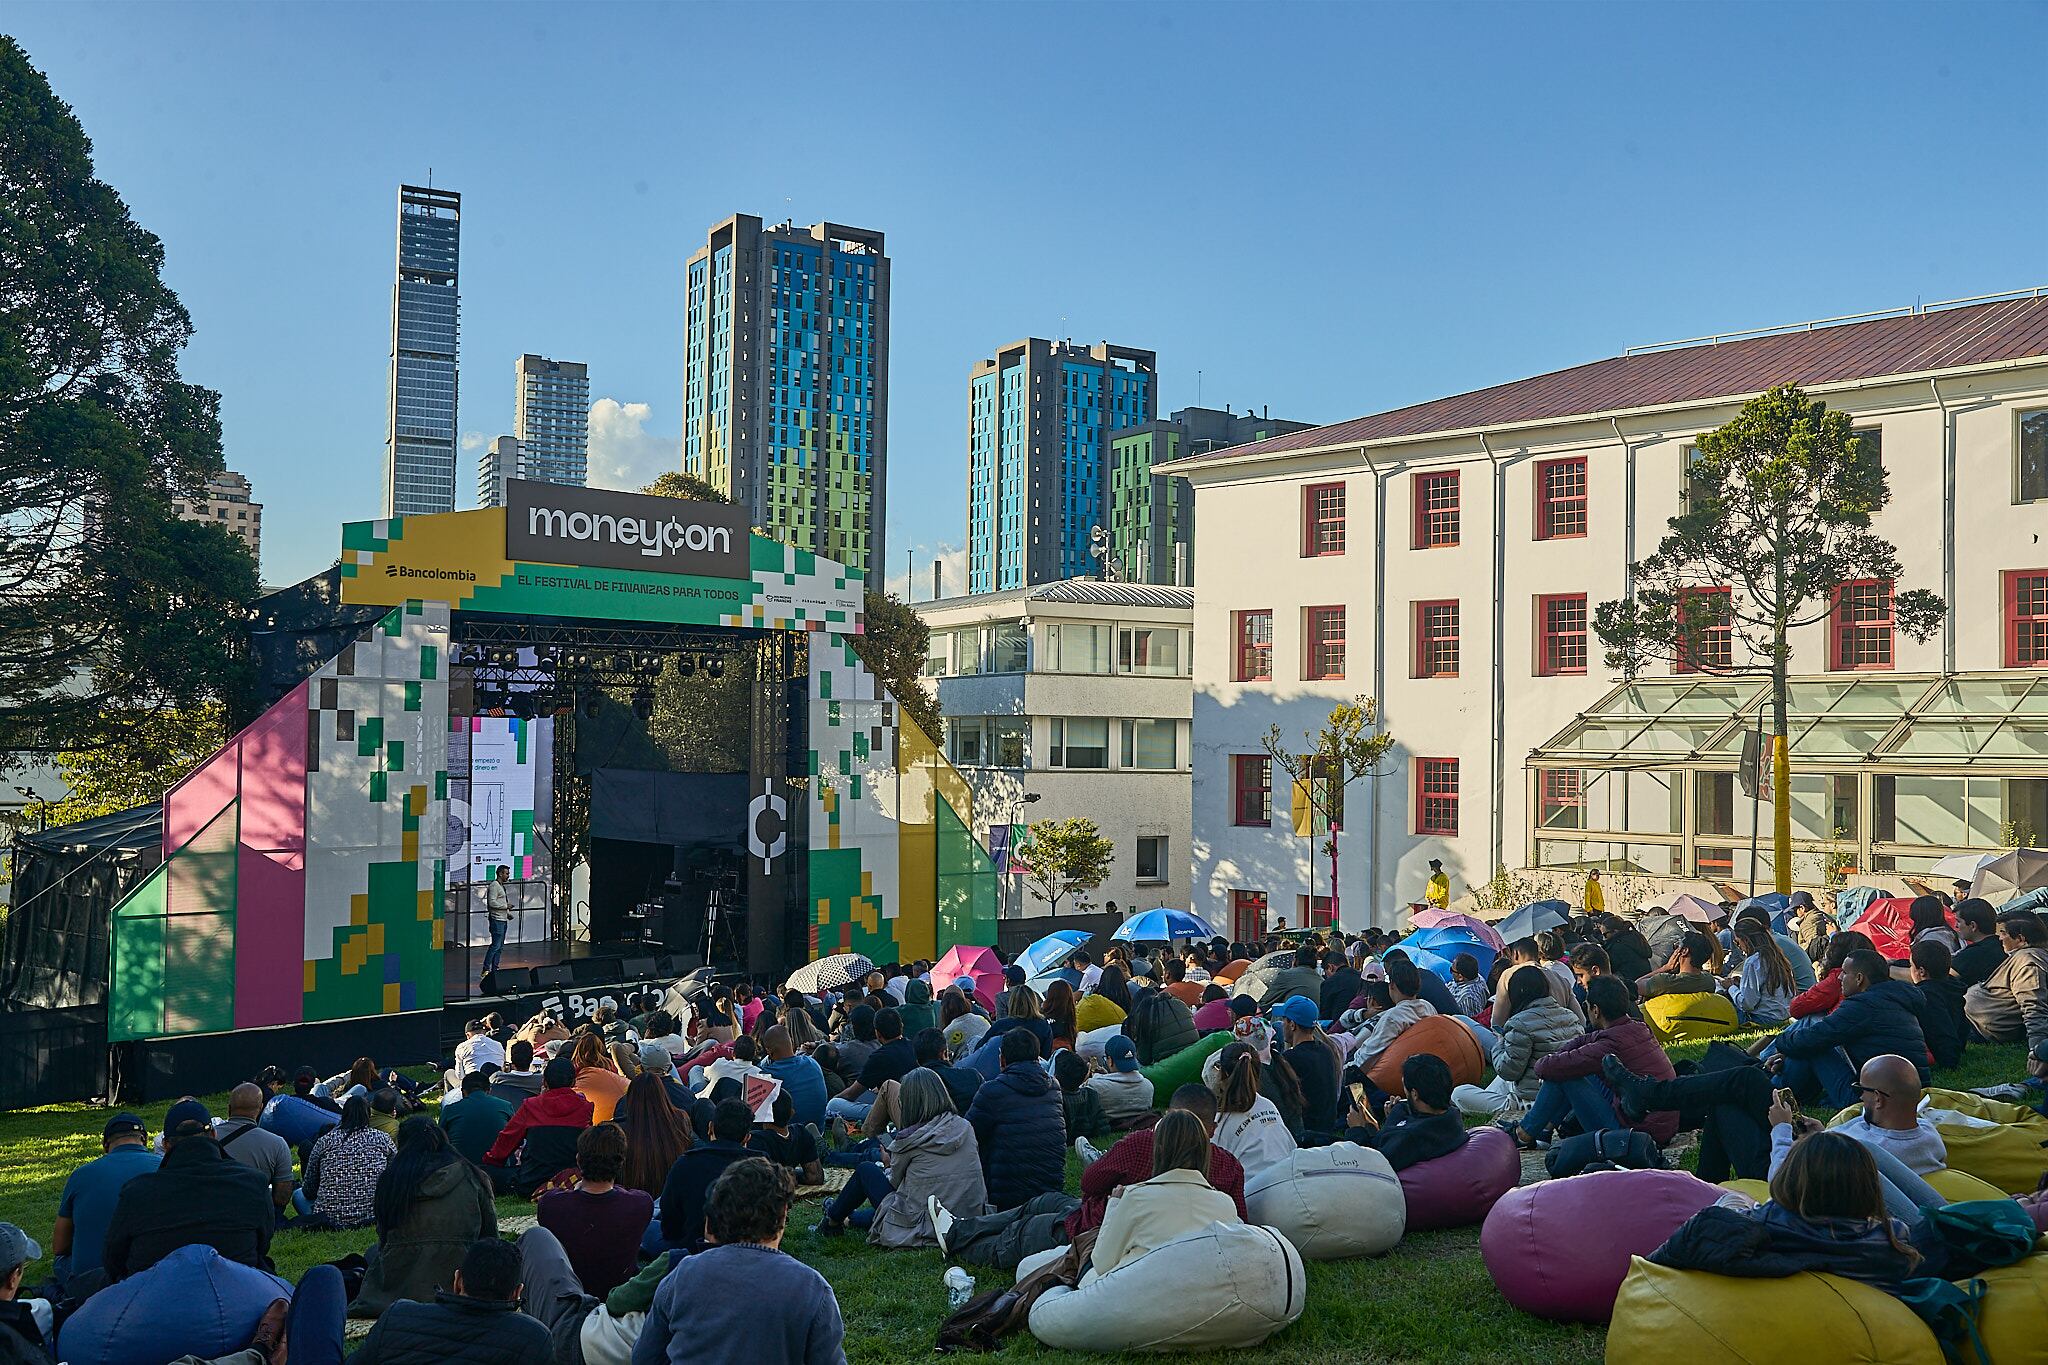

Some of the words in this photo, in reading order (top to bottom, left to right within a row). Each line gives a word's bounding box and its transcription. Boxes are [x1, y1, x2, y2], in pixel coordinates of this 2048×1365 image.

[399, 566, 476, 581] Bancolombia
[518, 575, 532, 586] EL
[535, 576, 591, 590] FESTIVAL
[594, 580, 609, 591] DE
[611, 581, 670, 596] FINANZAS
[672, 586, 701, 598] PARA
[703, 589, 739, 600] TODOS
